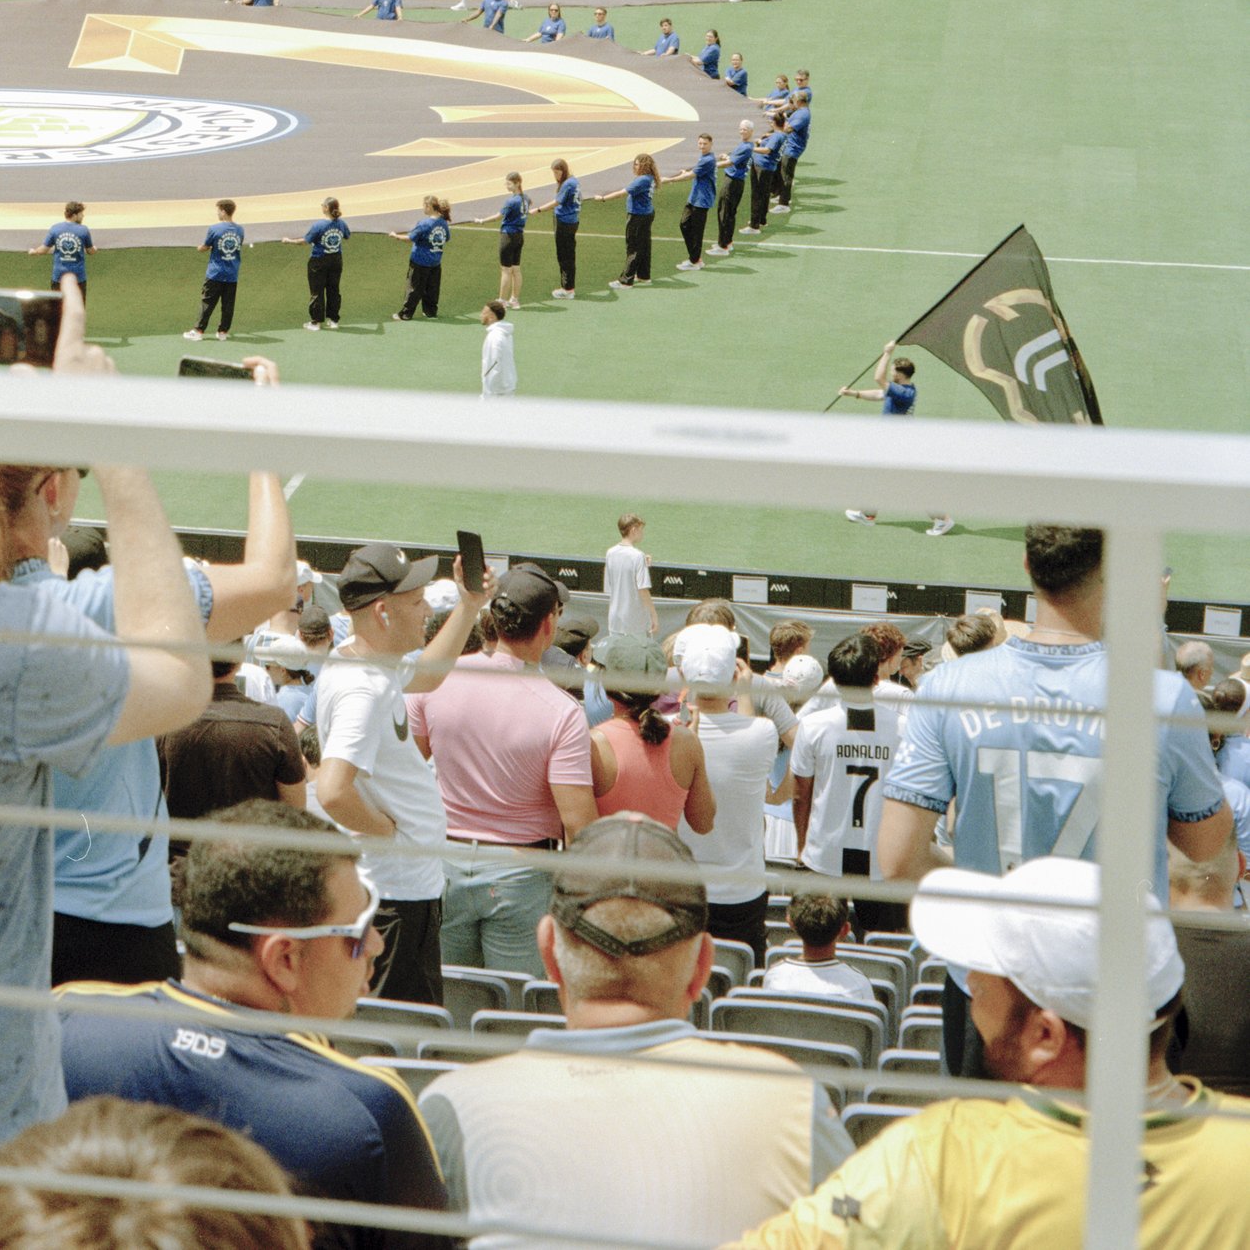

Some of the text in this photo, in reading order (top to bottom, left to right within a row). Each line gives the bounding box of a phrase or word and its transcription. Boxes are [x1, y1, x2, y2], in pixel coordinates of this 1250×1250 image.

[6, 100, 257, 161] MANCHESTER
[959, 703, 1003, 739] DE
[836, 744, 890, 760] RONALDO
[846, 764, 879, 828] 7
[978, 747, 1105, 879] 17
[171, 1028, 227, 1059] 1905
